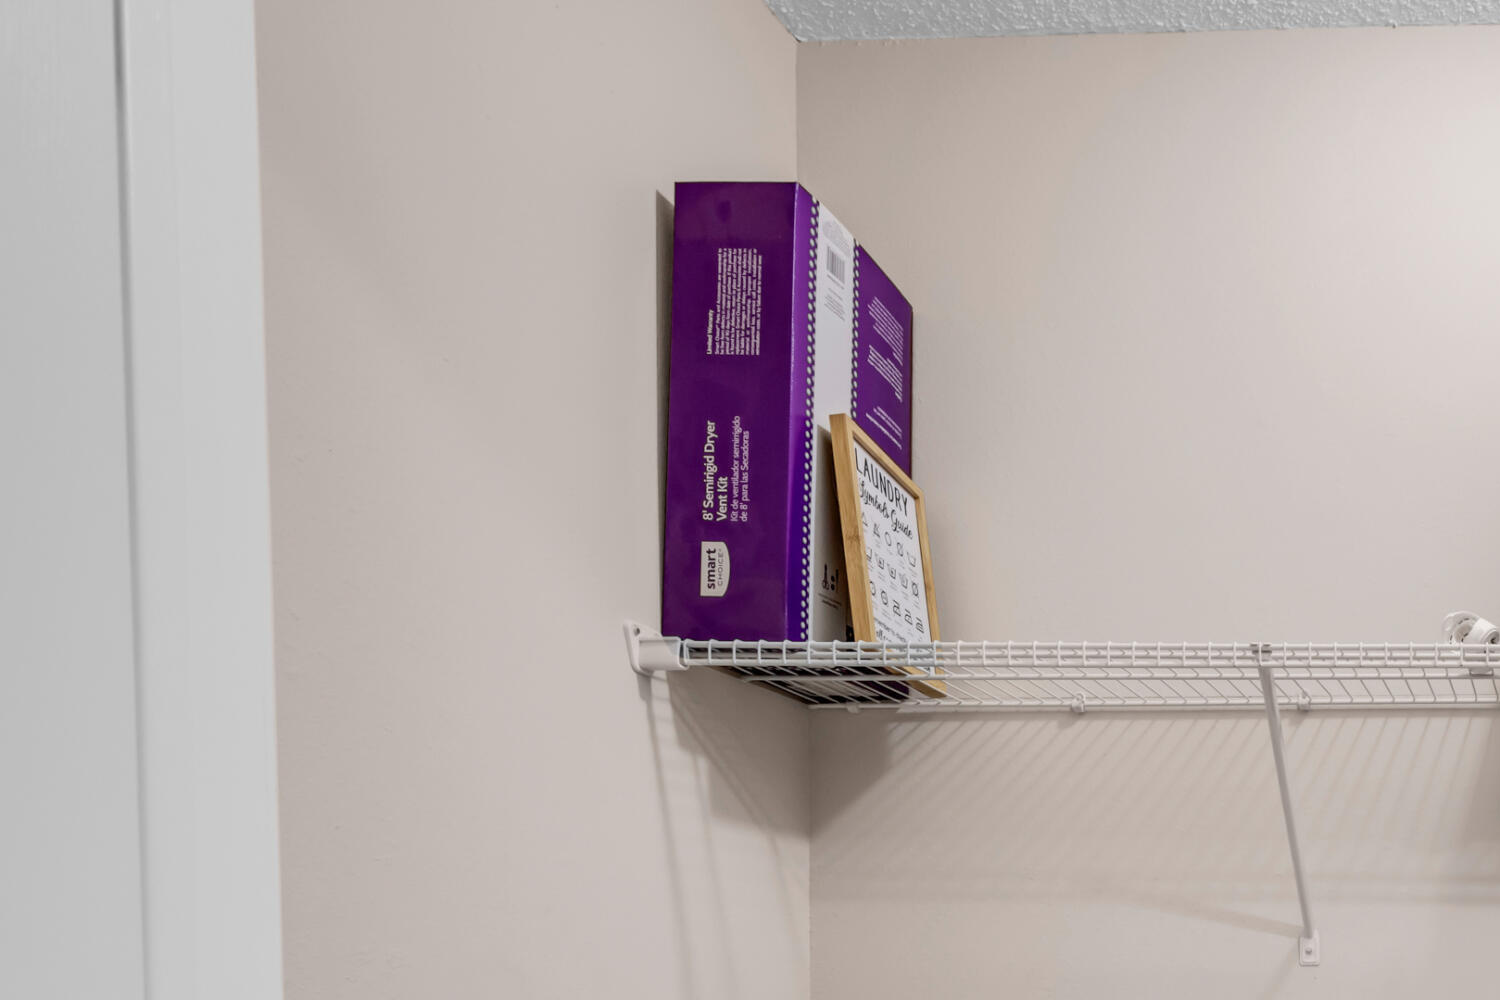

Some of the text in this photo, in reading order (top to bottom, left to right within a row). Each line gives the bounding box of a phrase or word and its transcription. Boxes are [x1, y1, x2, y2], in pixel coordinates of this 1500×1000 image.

[704, 420, 718, 453] Dryer
[741, 430, 750, 471] Secadoras
[703, 455, 718, 508] Semirigid
[731, 460, 740, 498] ventilador
[742, 484, 750, 502] para
[855, 447, 908, 517] LAUNDRY
[716, 476, 728, 522] Vent Kit
[731, 499, 738, 510] de
[890, 509, 913, 540] Guide
[706, 548, 716, 590] smart
